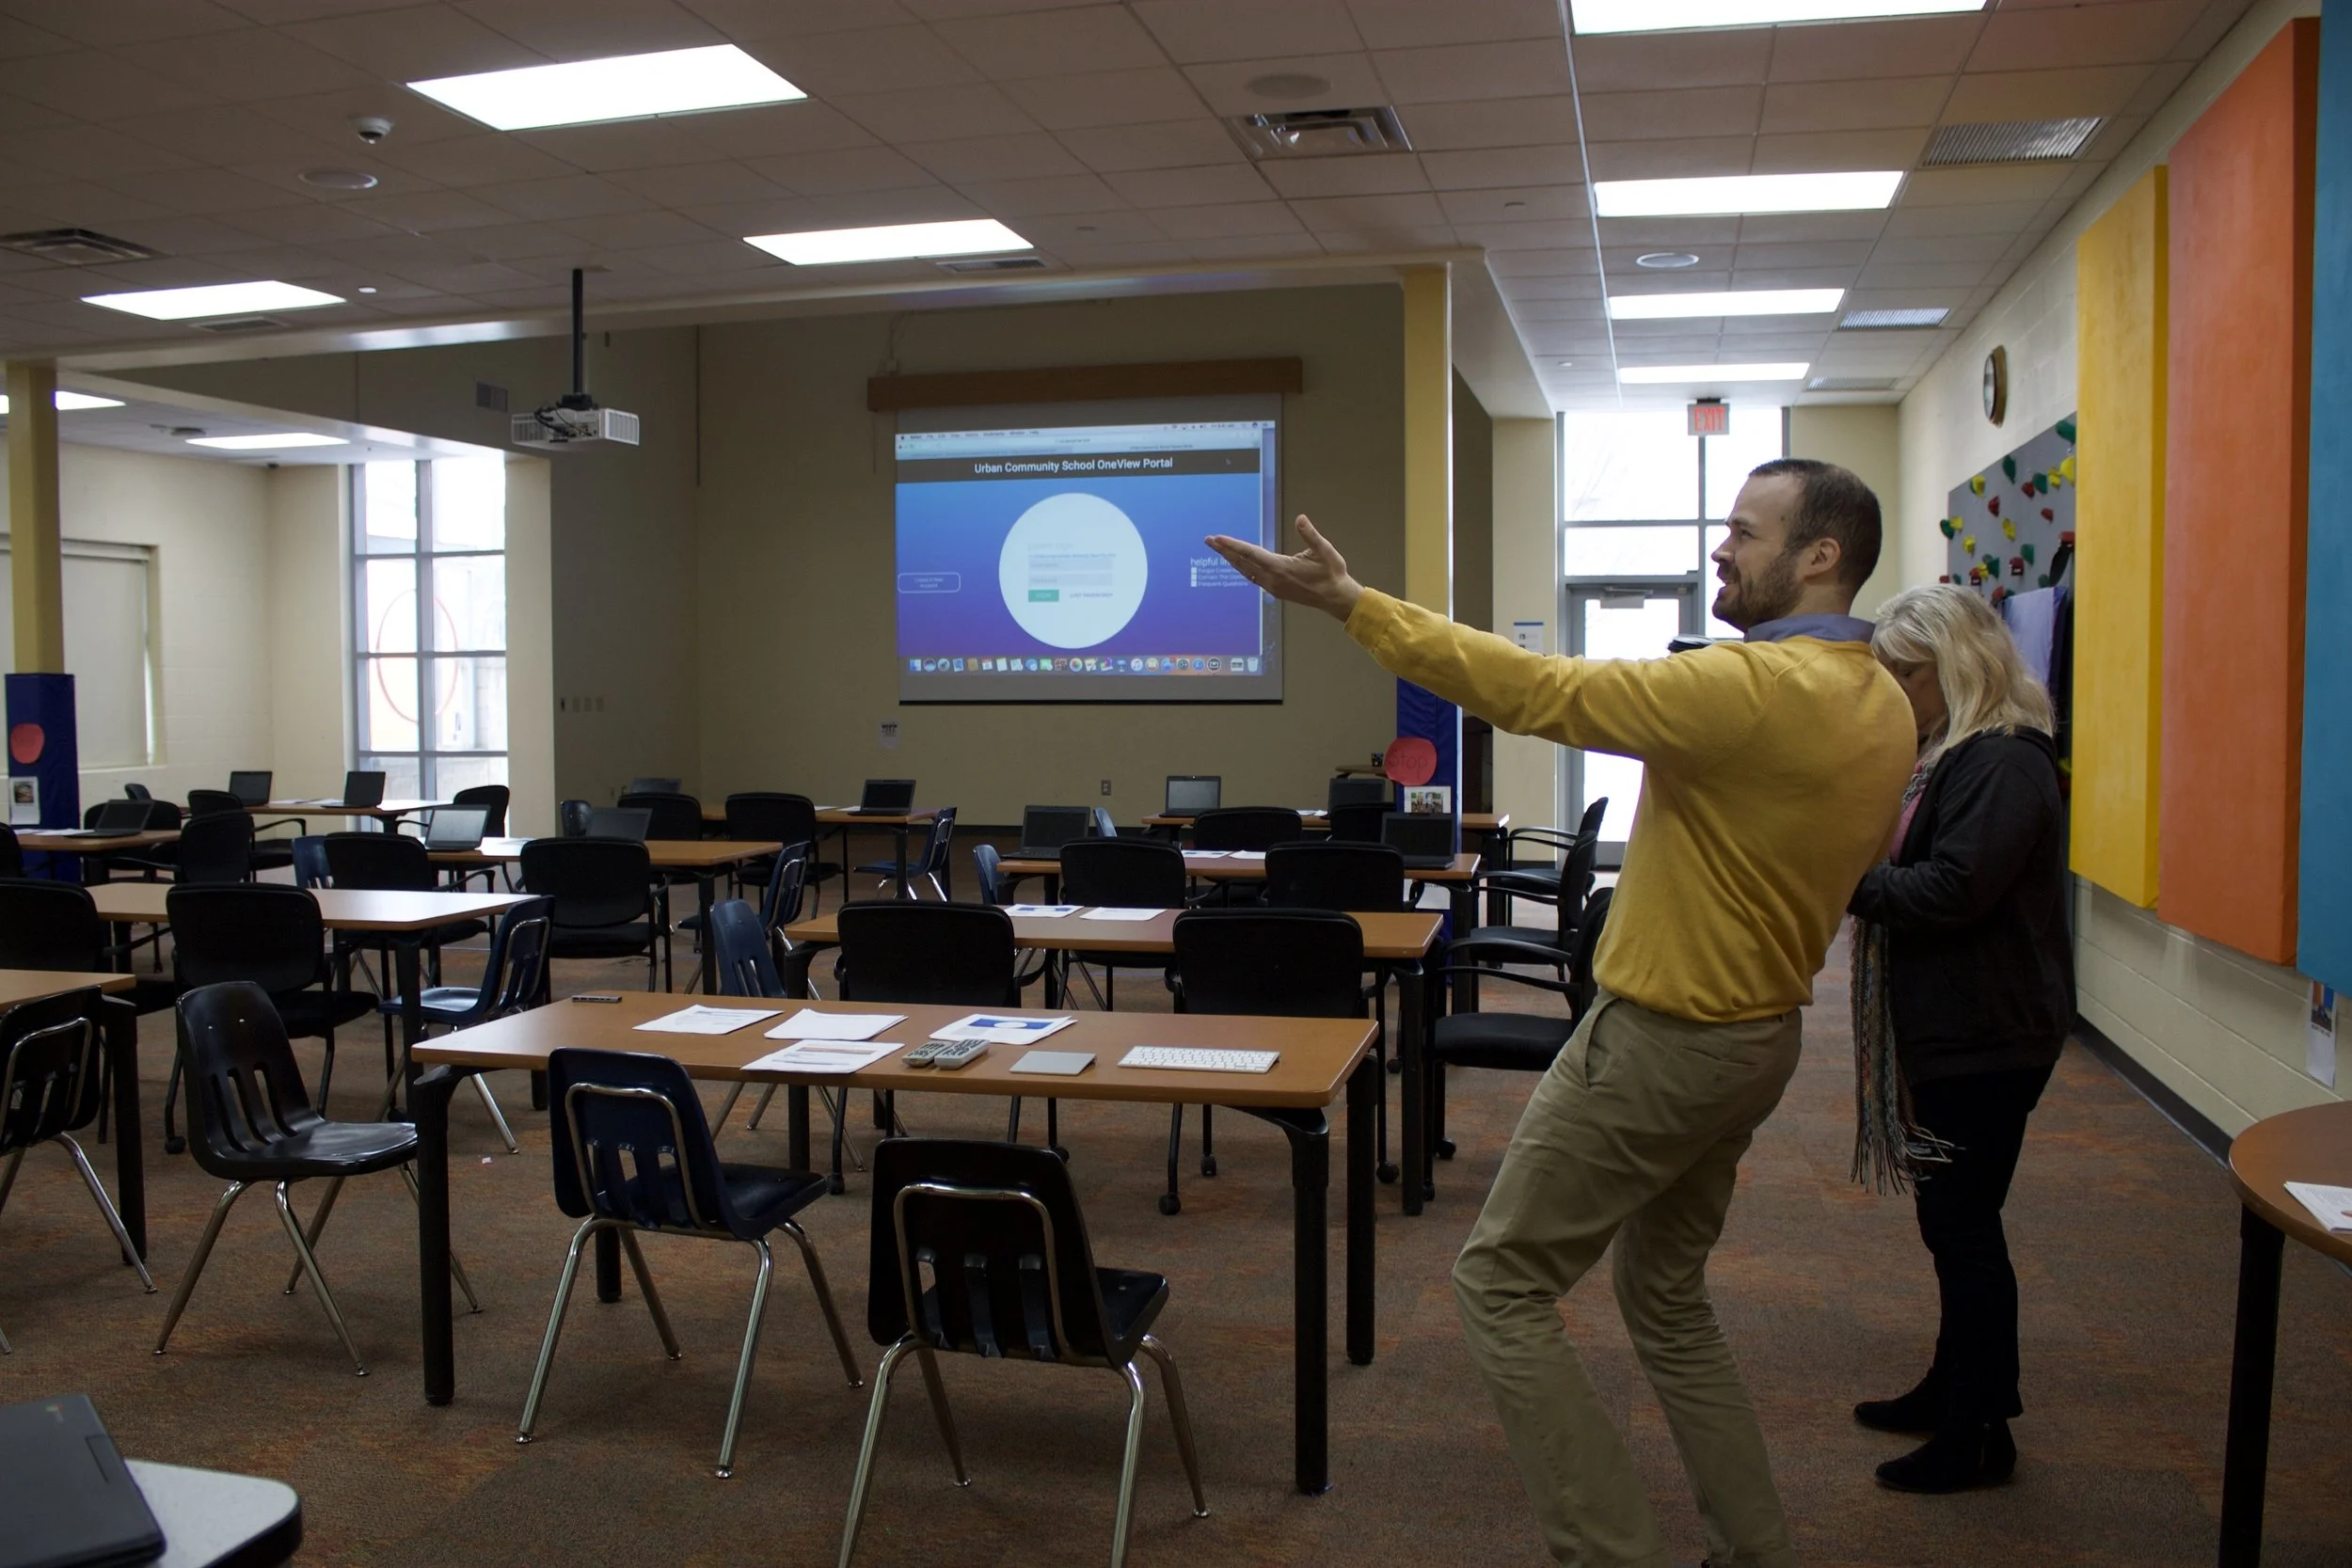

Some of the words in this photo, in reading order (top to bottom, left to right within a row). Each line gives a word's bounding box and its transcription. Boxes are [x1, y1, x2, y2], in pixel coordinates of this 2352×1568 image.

[1694, 405, 1724, 431] EXIT
[974, 463, 1003, 474] Urban
[1004, 460, 1060, 474] Community
[1061, 458, 1095, 471] School
[1097, 458, 1141, 470] OneView
[1142, 456, 1173, 468] Portal
[1190, 557, 1218, 568] helpful
[1387, 749, 1428, 780] Stop
